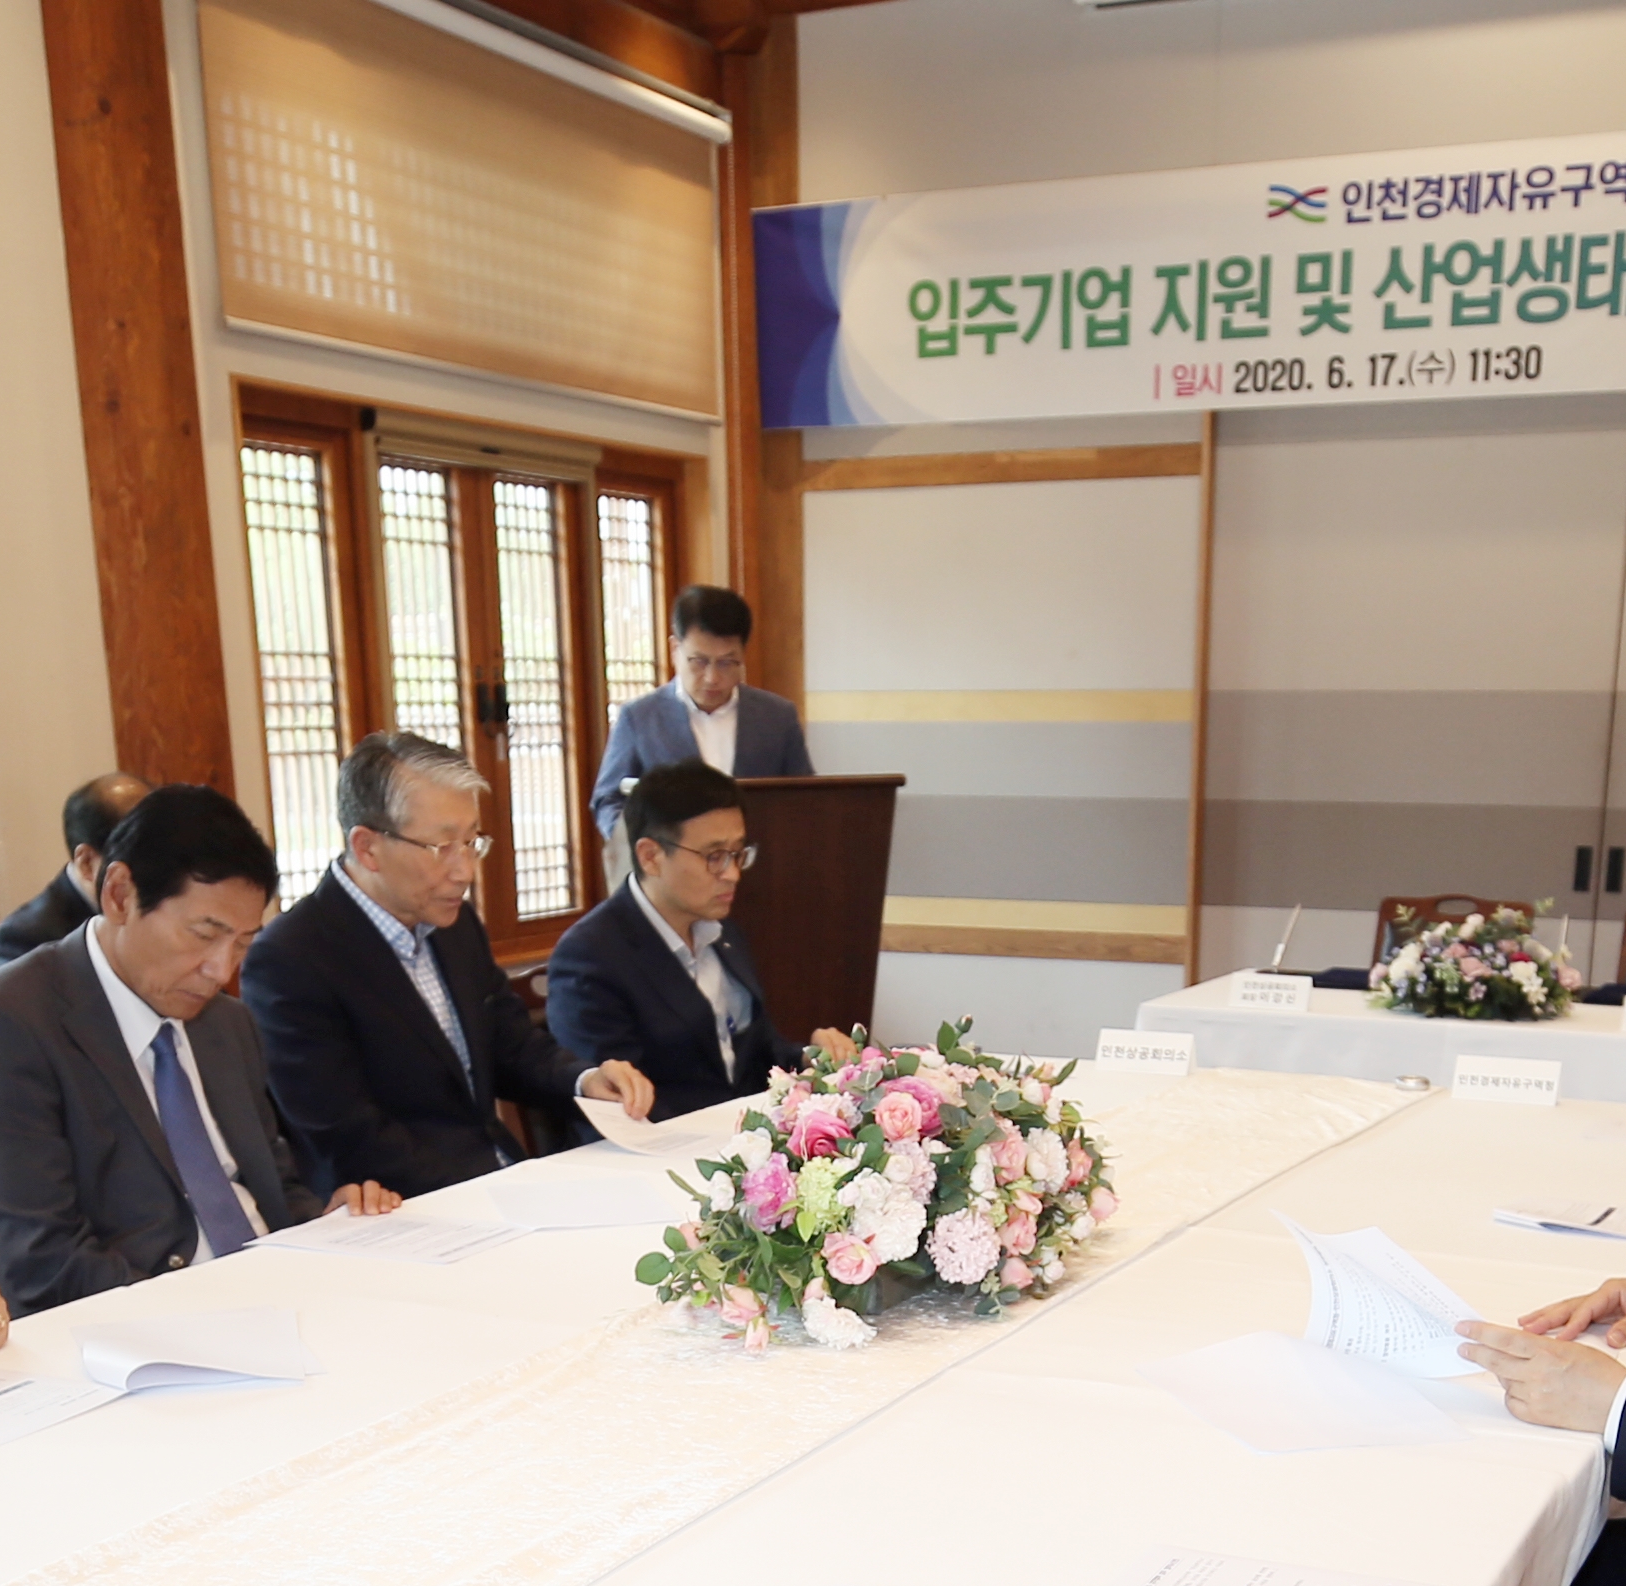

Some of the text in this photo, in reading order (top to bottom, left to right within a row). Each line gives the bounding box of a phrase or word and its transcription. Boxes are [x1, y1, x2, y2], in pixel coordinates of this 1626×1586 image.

[909, 266, 1132, 358] 입주기업
[1151, 255, 1271, 341] 지원
[1296, 250, 1353, 336] 및
[1173, 364, 1222, 397] 일시
[1234, 358, 1312, 394] 2020.
[1328, 356, 1353, 389] 6.
[1470, 346, 1542, 381] 11:30
[1101, 1045, 1187, 1061] 인천상공회의소
